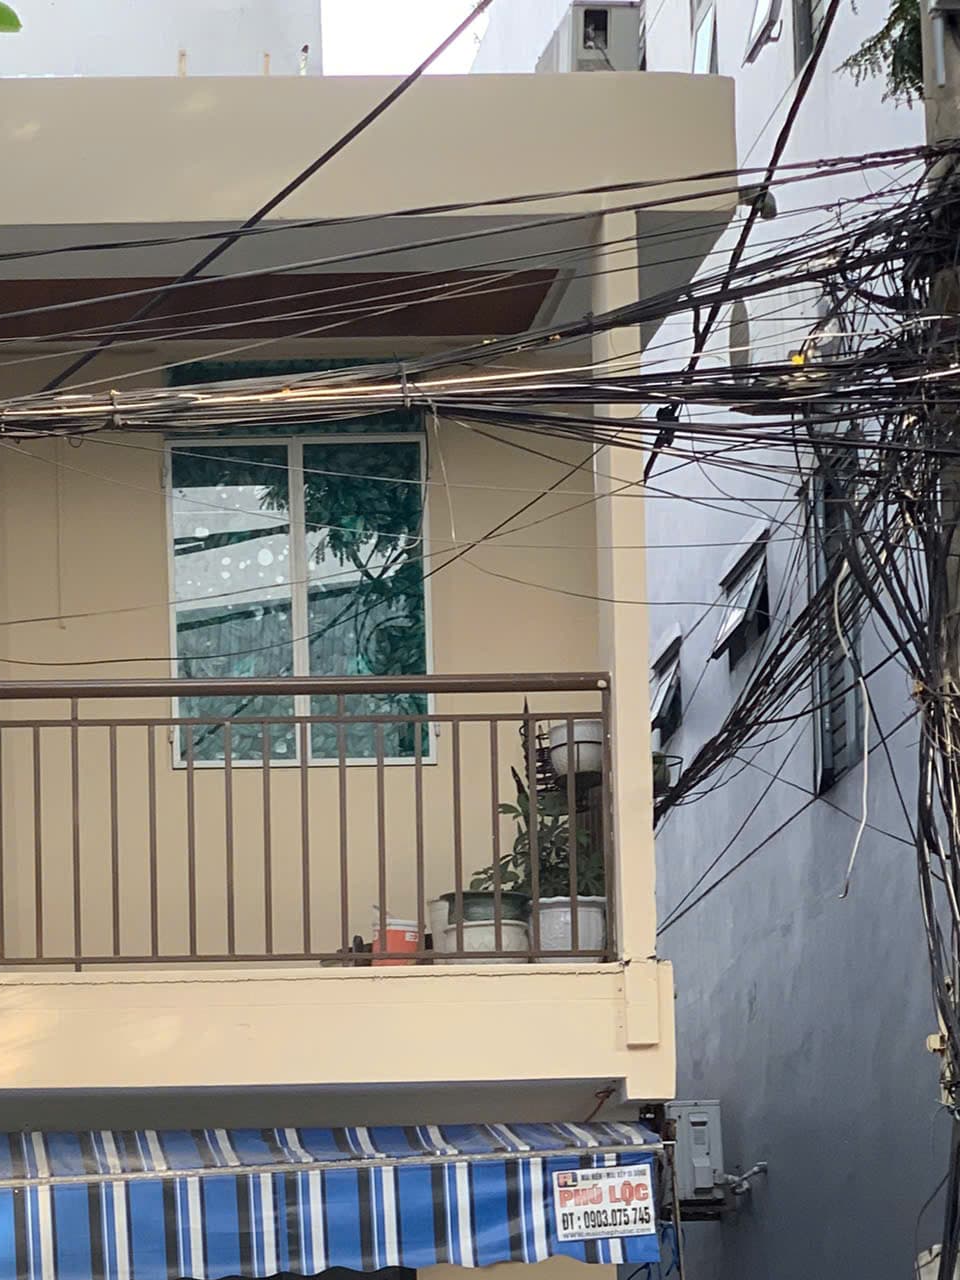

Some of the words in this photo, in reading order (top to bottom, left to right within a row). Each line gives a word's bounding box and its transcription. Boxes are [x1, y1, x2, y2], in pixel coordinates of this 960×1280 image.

[559, 1184, 603, 1208] PHÚ
[609, 1180, 649, 1206] LỘC
[632, 1206, 651, 1225] 745
